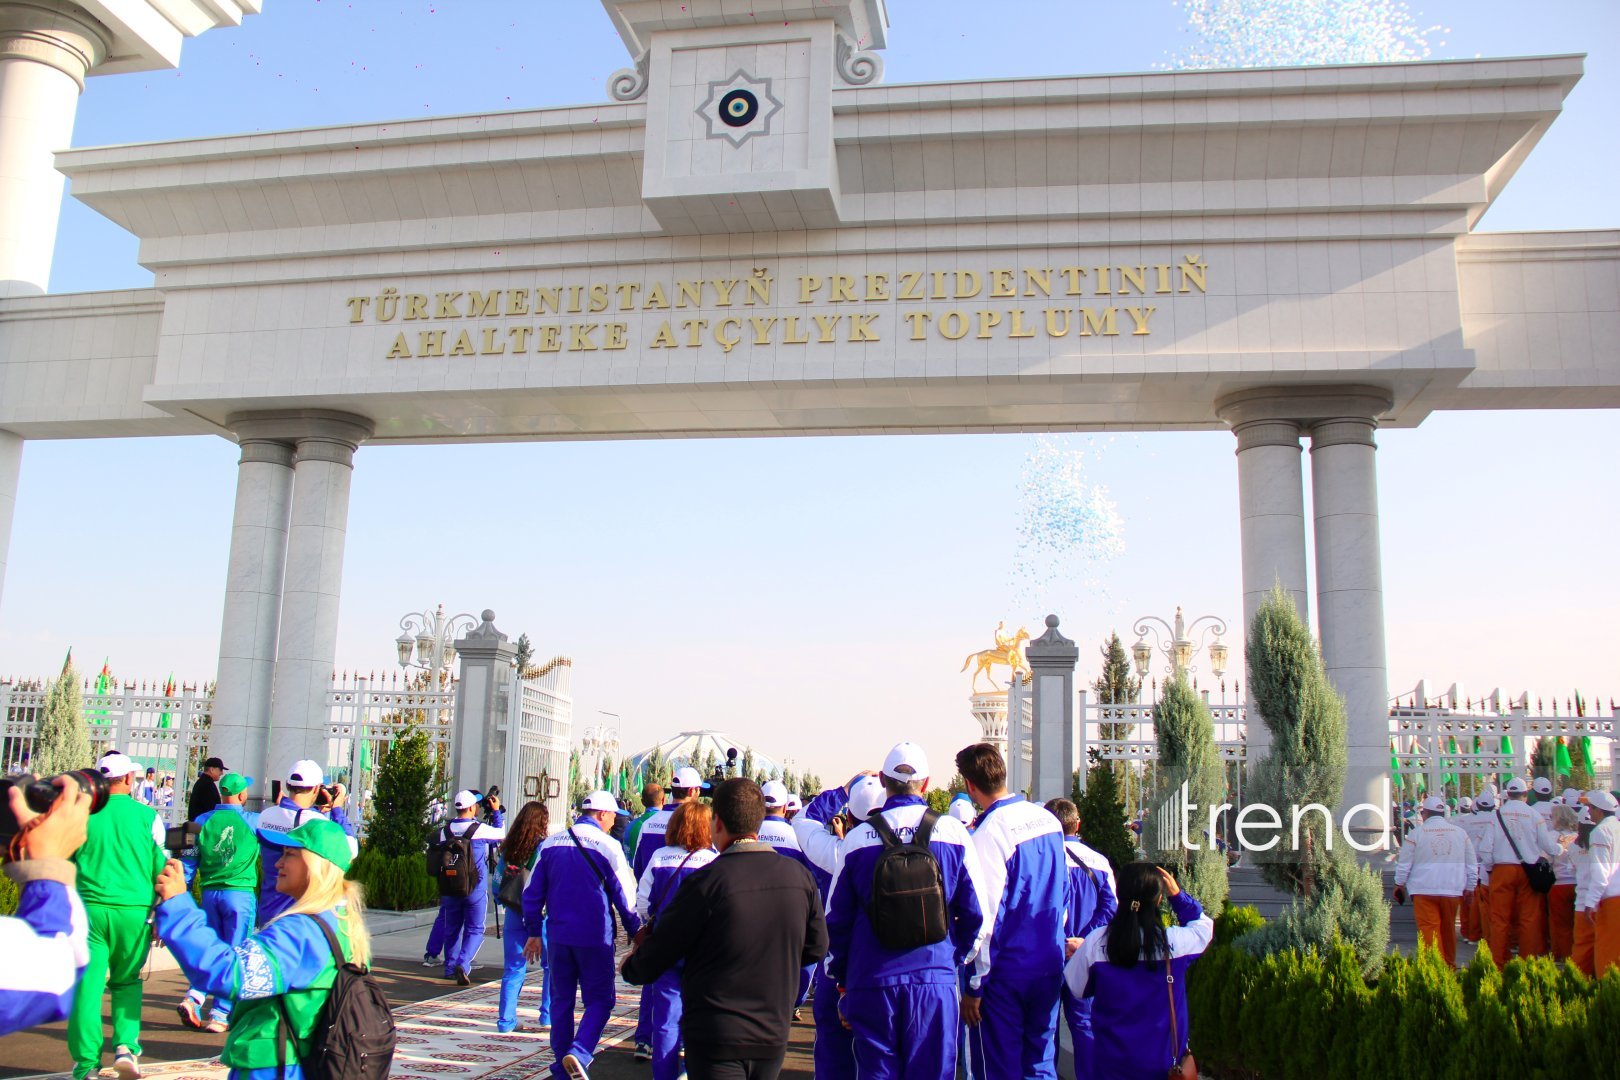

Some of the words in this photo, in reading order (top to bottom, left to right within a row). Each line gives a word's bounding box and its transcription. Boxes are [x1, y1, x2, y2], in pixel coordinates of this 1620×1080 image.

[347, 267, 773, 323] TÜRKMENISTANYŇ
[798, 255, 1208, 303] PREZIDENTINIŇ
[386, 322, 628, 359] AHALTEKE
[649, 313, 881, 353] ATÇYLYK
[904, 306, 1156, 341] TOPLUMY
[261, 822, 293, 834] TÜRKMENIS
